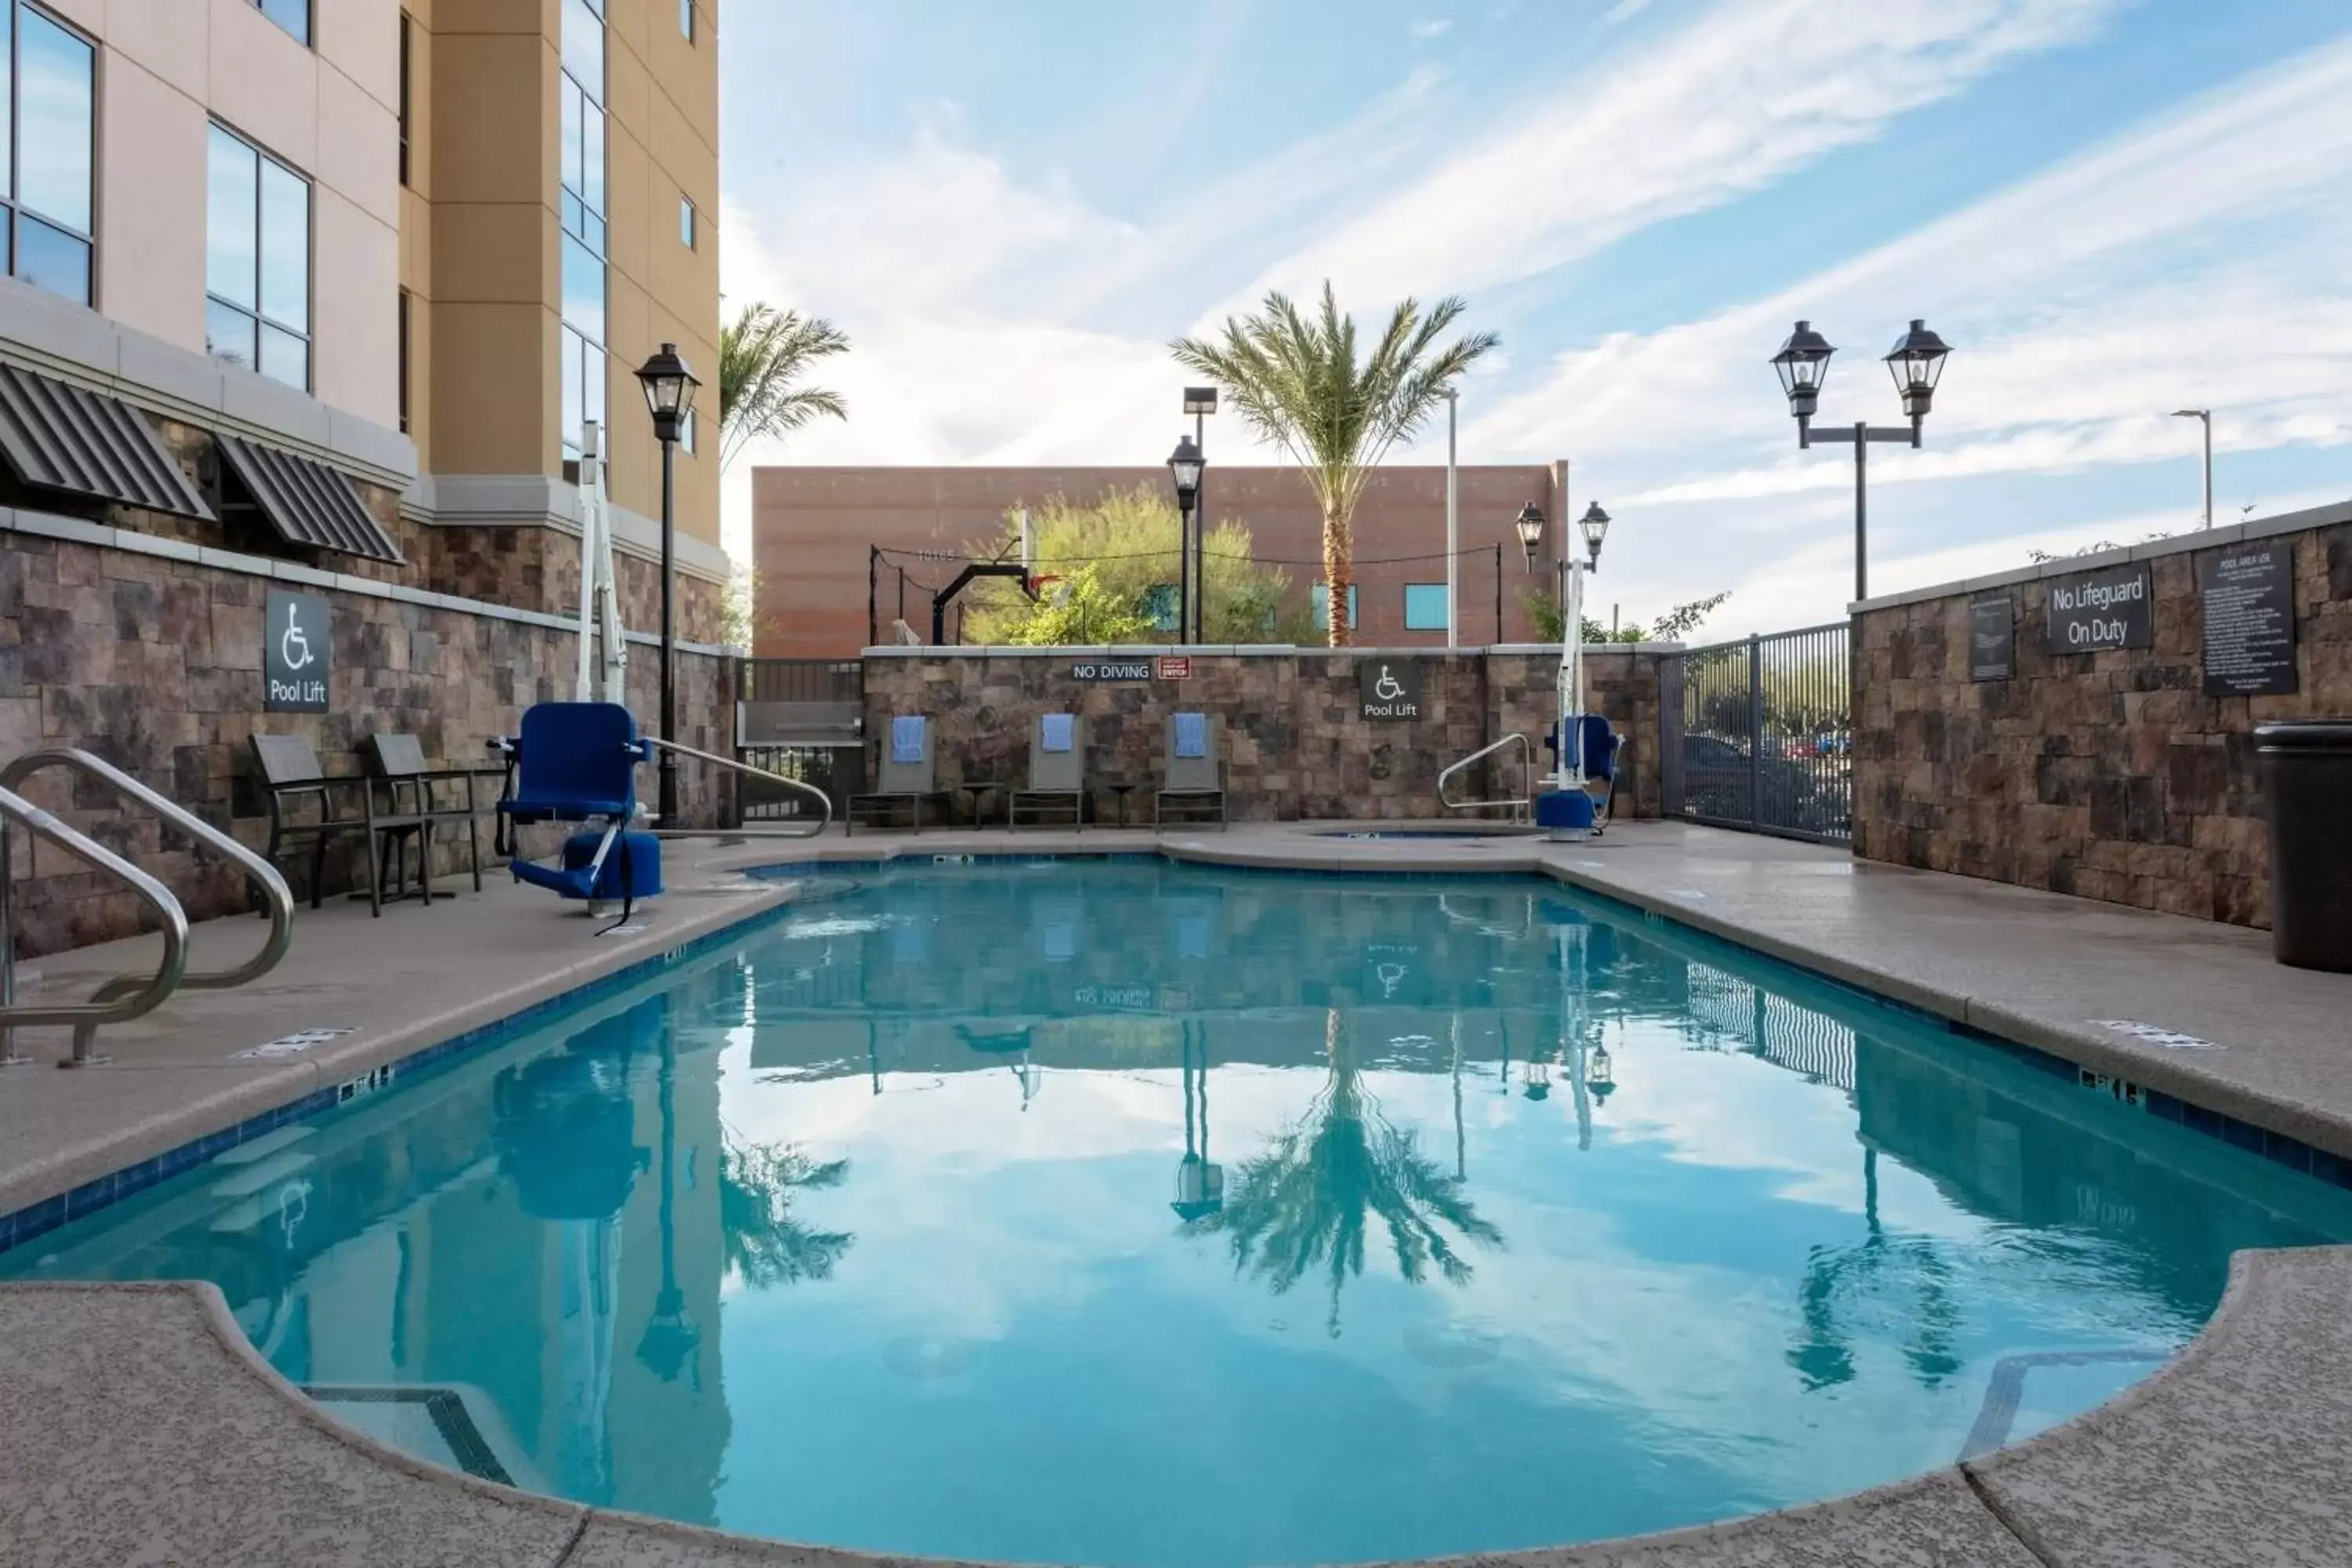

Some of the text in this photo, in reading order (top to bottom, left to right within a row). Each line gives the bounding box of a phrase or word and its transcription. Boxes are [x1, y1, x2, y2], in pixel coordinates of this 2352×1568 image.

[2054, 574, 2143, 611] No Lifeguard
[2068, 619, 2128, 645] On Duty
[1074, 666, 1149, 678] NO DIVING
[270, 679, 326, 703] Pool Lift
[1364, 703, 1417, 716] Pool Lift
